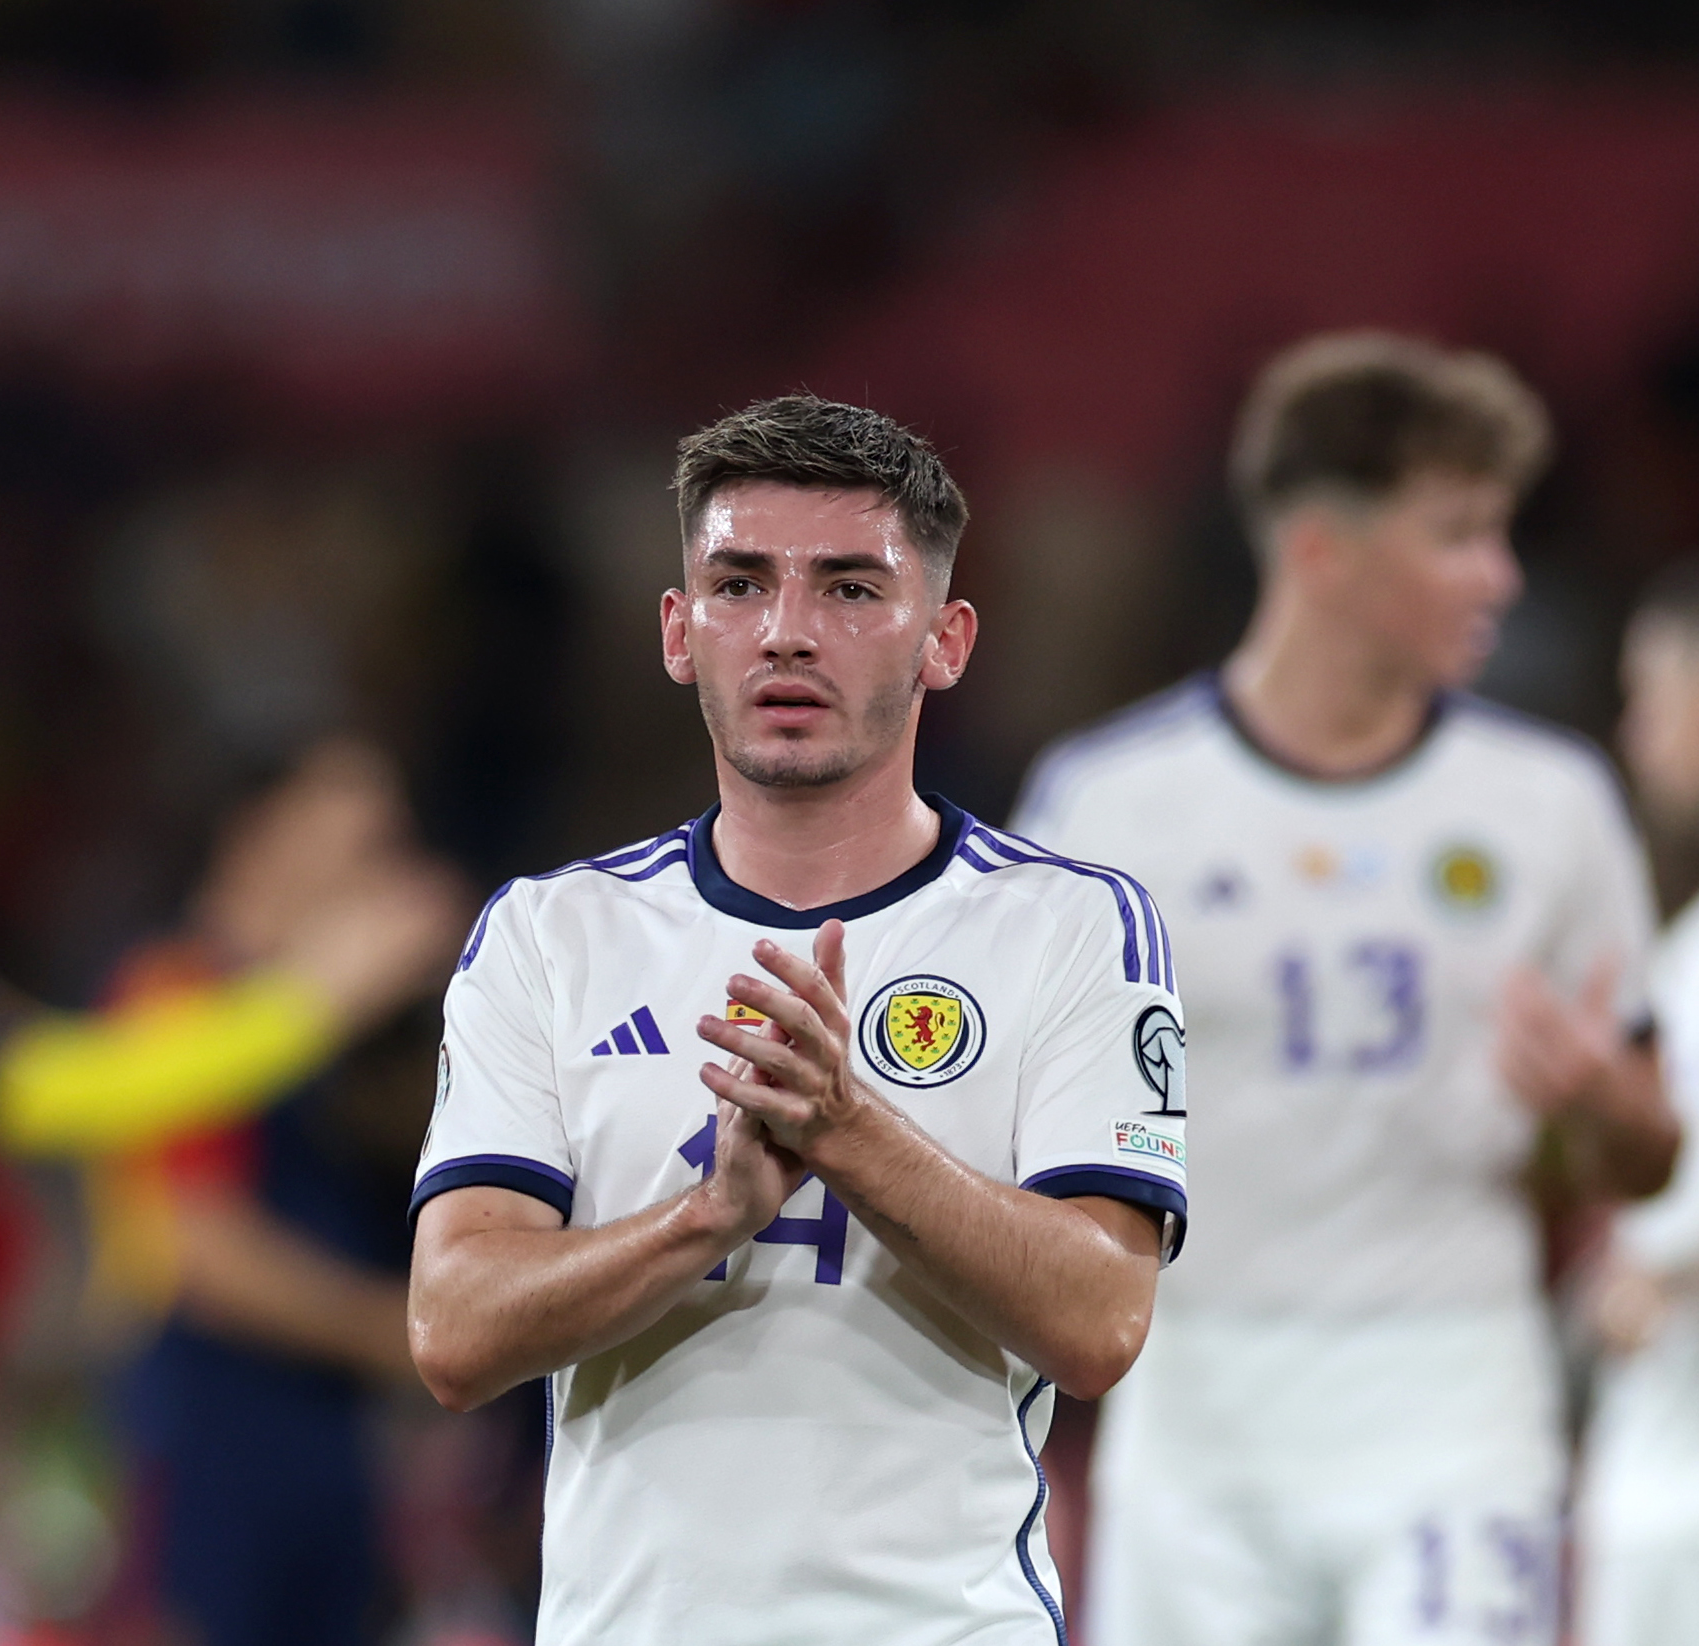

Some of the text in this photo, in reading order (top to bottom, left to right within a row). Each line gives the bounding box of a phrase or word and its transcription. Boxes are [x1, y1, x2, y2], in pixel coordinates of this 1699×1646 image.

[897, 981, 956, 997] SCOTLAND
[1273, 935, 1429, 1078] 13
[876, 1059, 893, 1074] EST
[944, 1063, 964, 1077] 1873
[1115, 1122, 1147, 1134] UEFA
[1116, 1132, 1186, 1162] FOUND
